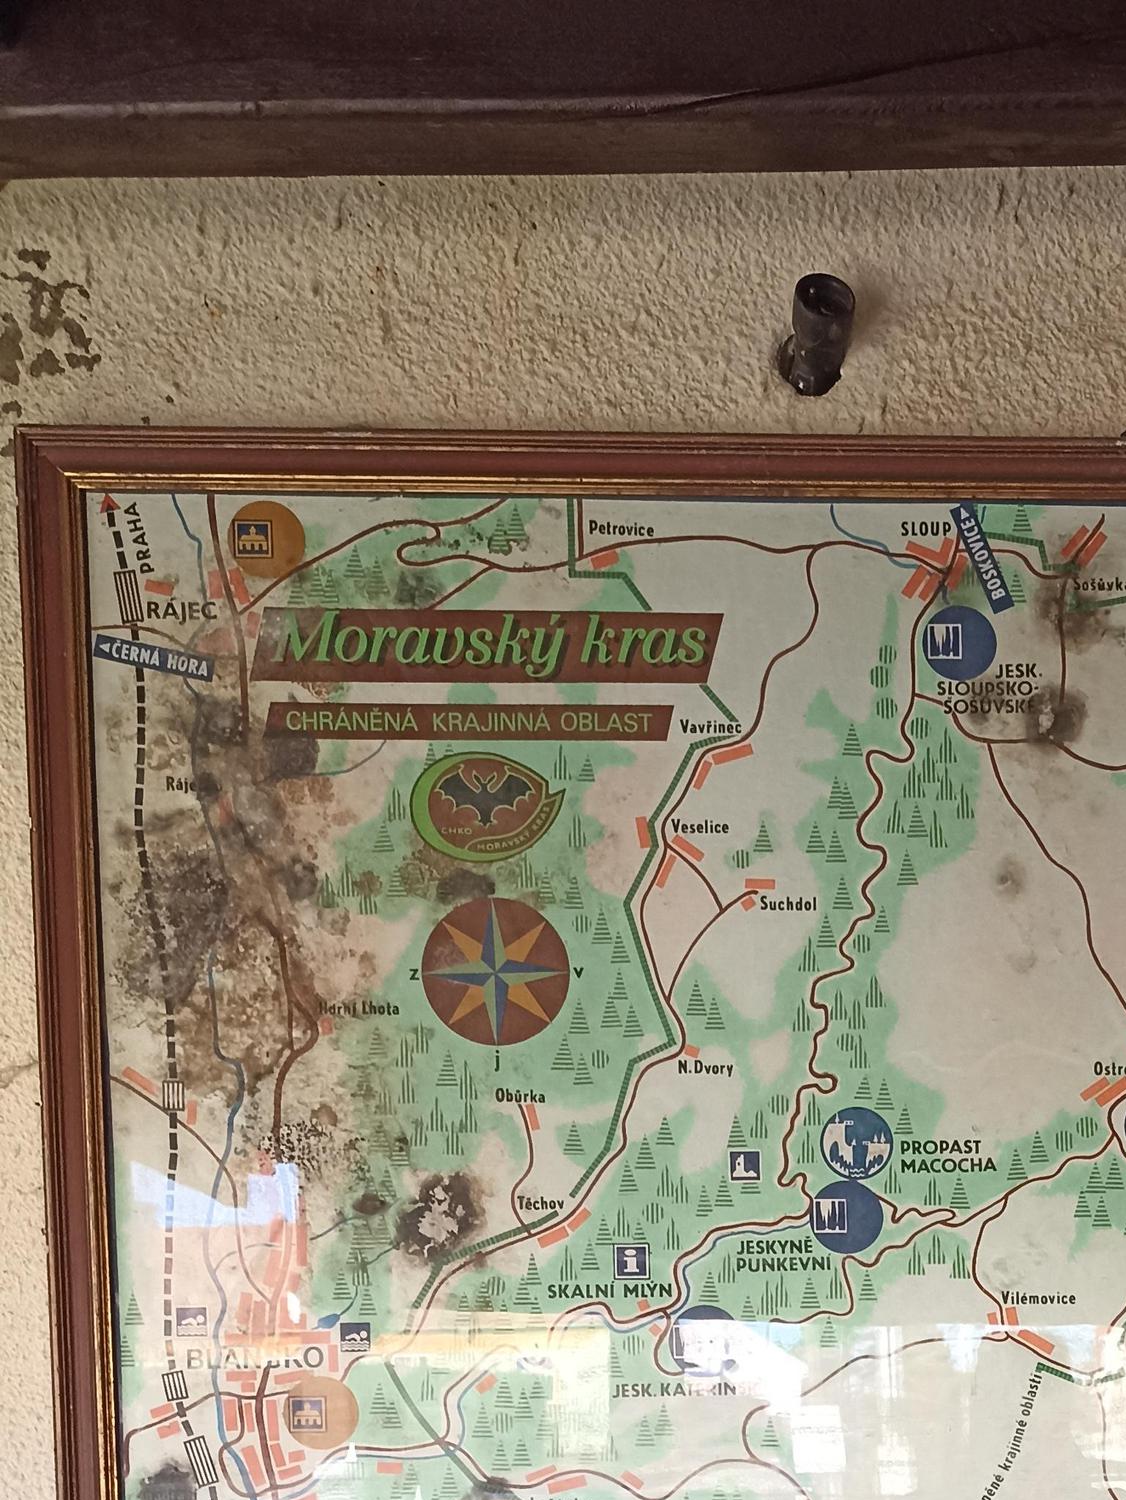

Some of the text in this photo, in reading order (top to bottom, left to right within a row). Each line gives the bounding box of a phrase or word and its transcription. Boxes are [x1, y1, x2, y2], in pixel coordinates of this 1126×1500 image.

[123, 501, 155, 574] PRAHA
[588, 519, 655, 539] Petrovice
[901, 521, 951, 538] SLOUP
[960, 518, 1006, 601] BOSKOVICE
[147, 597, 218, 626] RÁJEC
[271, 609, 709, 678] Moravský kras
[111, 640, 209, 677] ČERNÁ HORA
[995, 663, 1043, 679] JESK.
[937, 681, 1039, 696] SLOUPSKO-
[285, 705, 654, 734] CHRÁNĚNÁ KRAJINNÁ OBLAST
[680, 718, 743, 735] Vavřinec
[441, 826, 473, 836] CHKO
[671, 818, 730, 835] Veselice
[759, 895, 818, 912] Suchdol
[409, 968, 420, 981] Z
[361, 1000, 400, 1016] Lhota
[495, 1087, 546, 1104] Obůrka
[900, 1138, 982, 1155] PROPAST
[900, 1157, 998, 1174] MACOCHA
[516, 1194, 565, 1211] Těchov
[736, 1236, 814, 1255] JESKYNĚ
[736, 1255, 832, 1273] PUNKEVNÍ
[547, 1280, 673, 1299] SKALNÍ MLÝN
[1001, 1290, 1077, 1306] Vilémovice
[998, 1419, 1028, 1472] krajinné
[1020, 1372, 1043, 1417] oblasti
